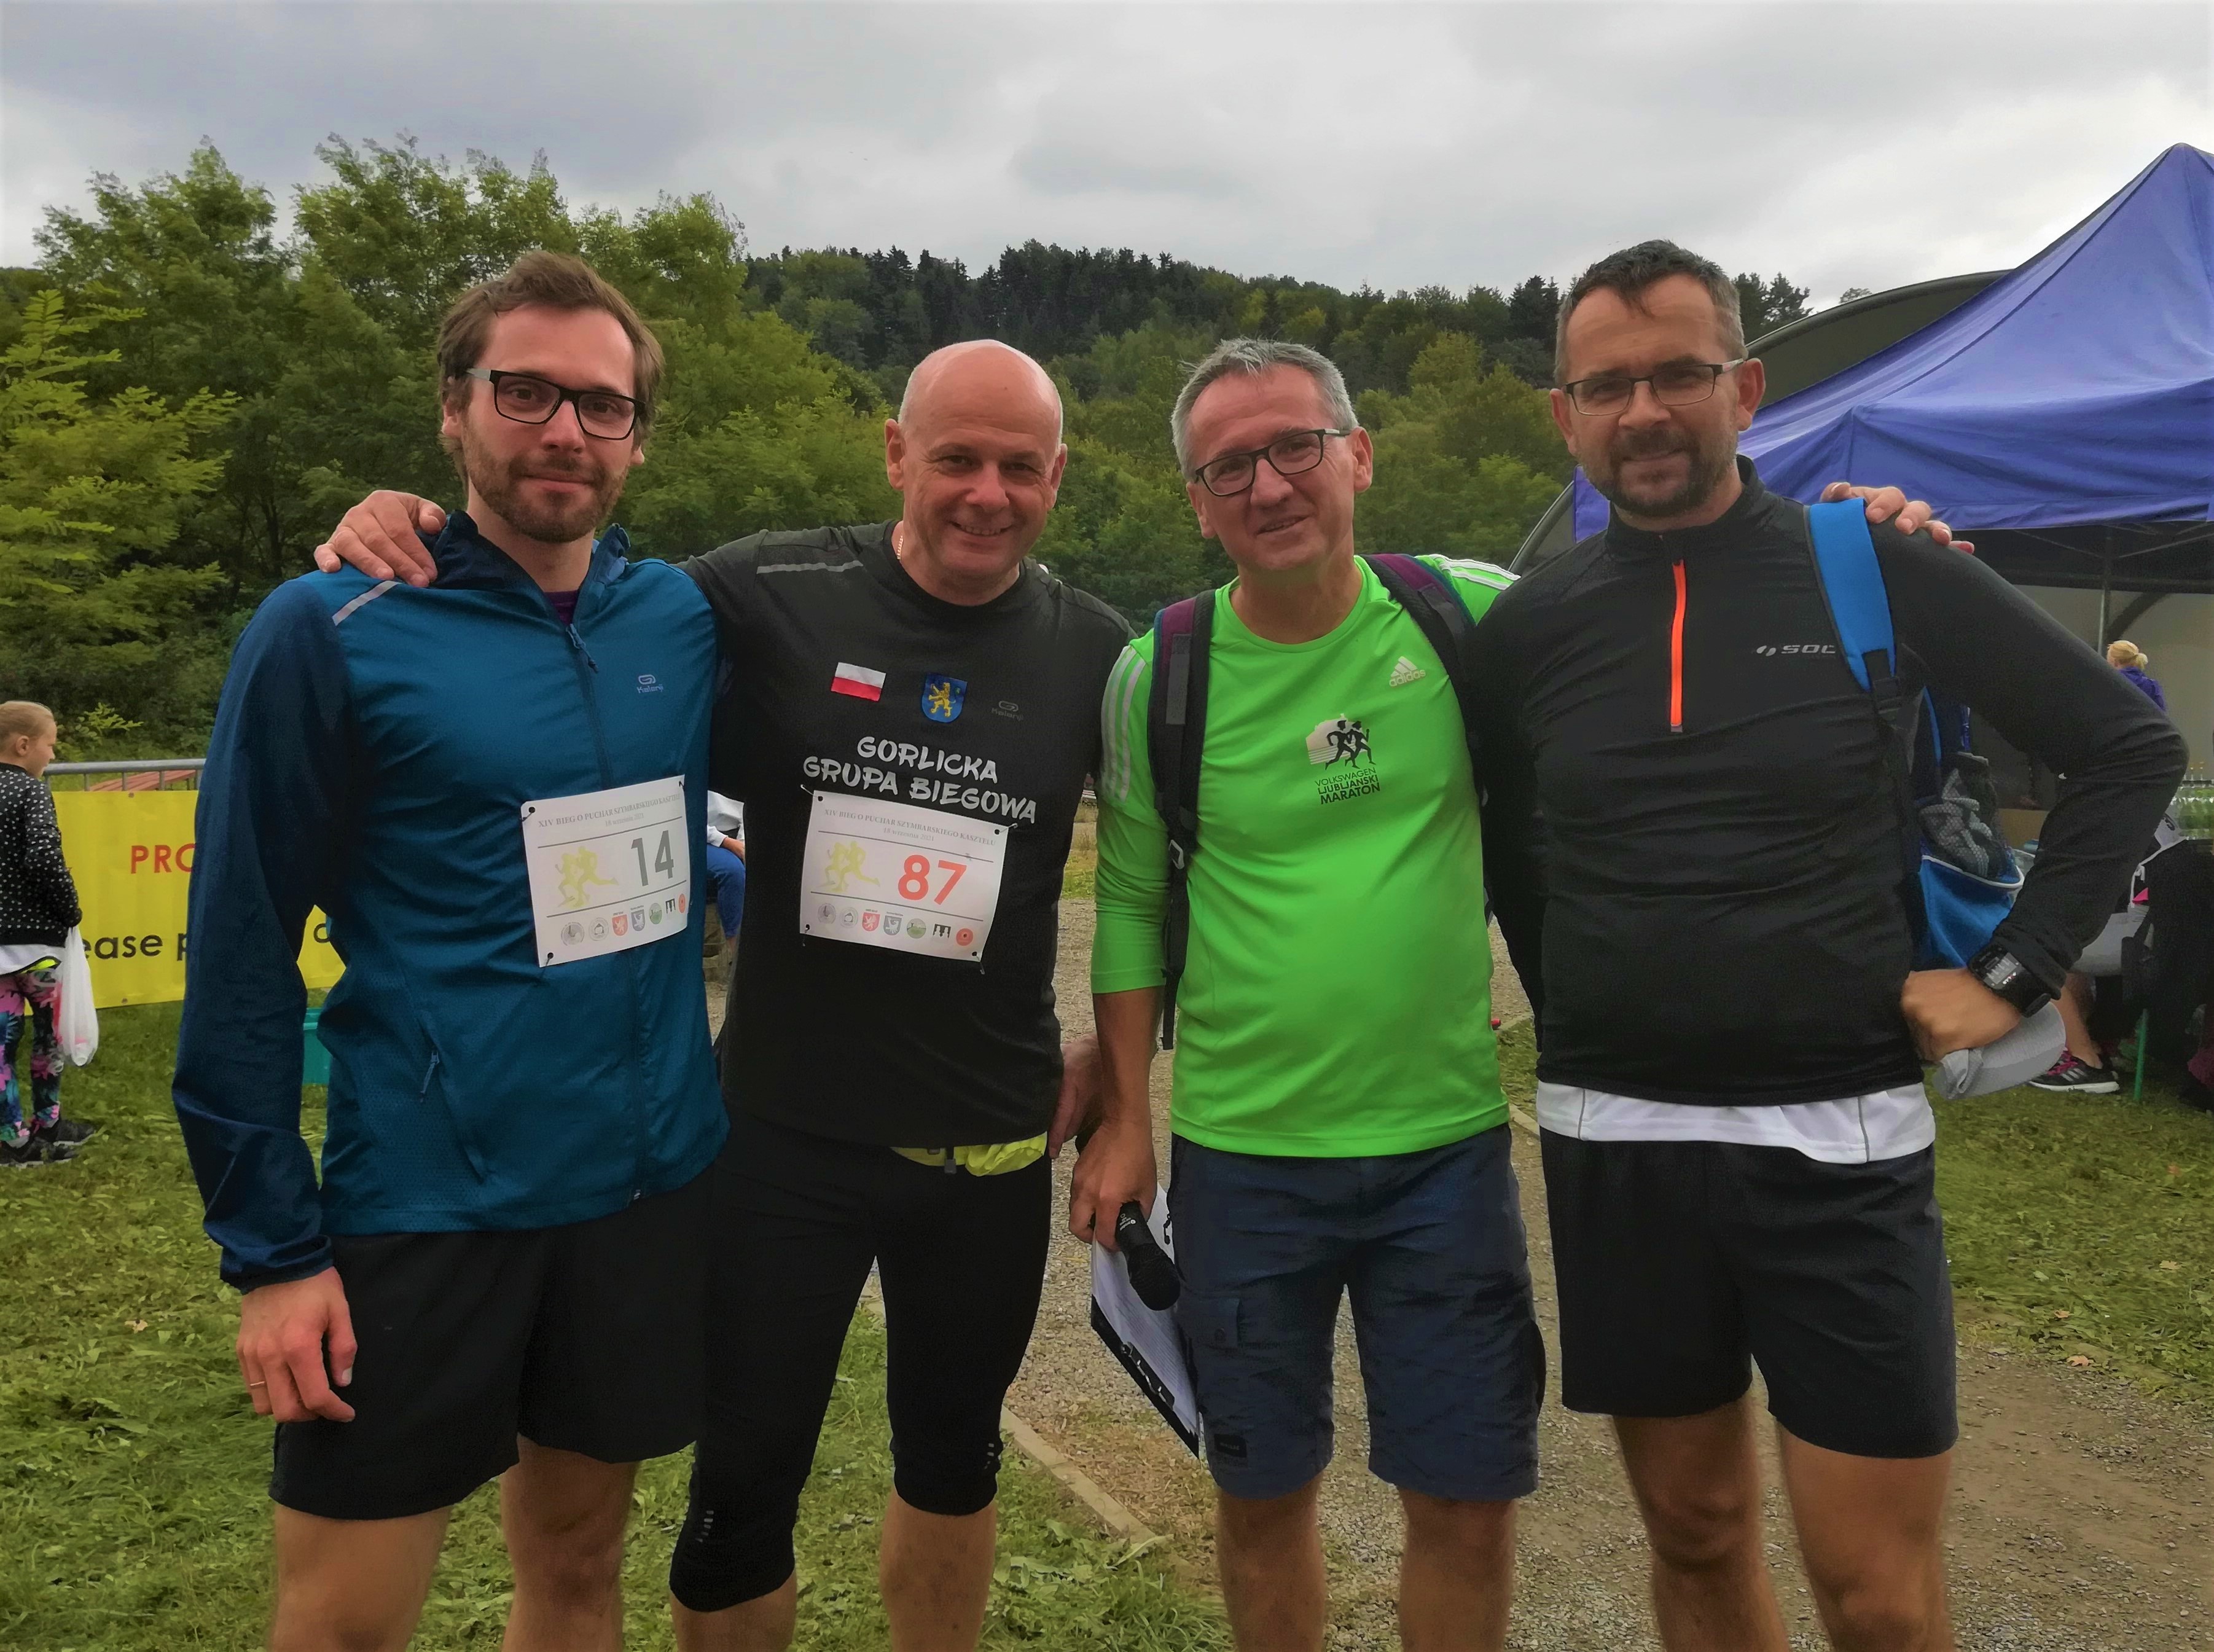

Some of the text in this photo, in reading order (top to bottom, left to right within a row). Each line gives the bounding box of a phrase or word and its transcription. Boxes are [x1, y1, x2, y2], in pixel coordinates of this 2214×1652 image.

[1389, 669, 1426, 687] adidas
[857, 736, 998, 784] GORLICKA
[1315, 767, 1376, 786] VOLKSWAGEN
[1318, 775, 1379, 794] LJUBLJANSKI
[803, 756, 1037, 824] GRUPA BIEGOWA
[1321, 782, 1380, 805] MARATON
[538, 818, 554, 828] XIV
[556, 815, 576, 825] BIEG
[585, 809, 613, 820] PUCHAR
[865, 815, 896, 826] PUCHAR
[631, 830, 674, 887] 14
[898, 855, 967, 905] 87
